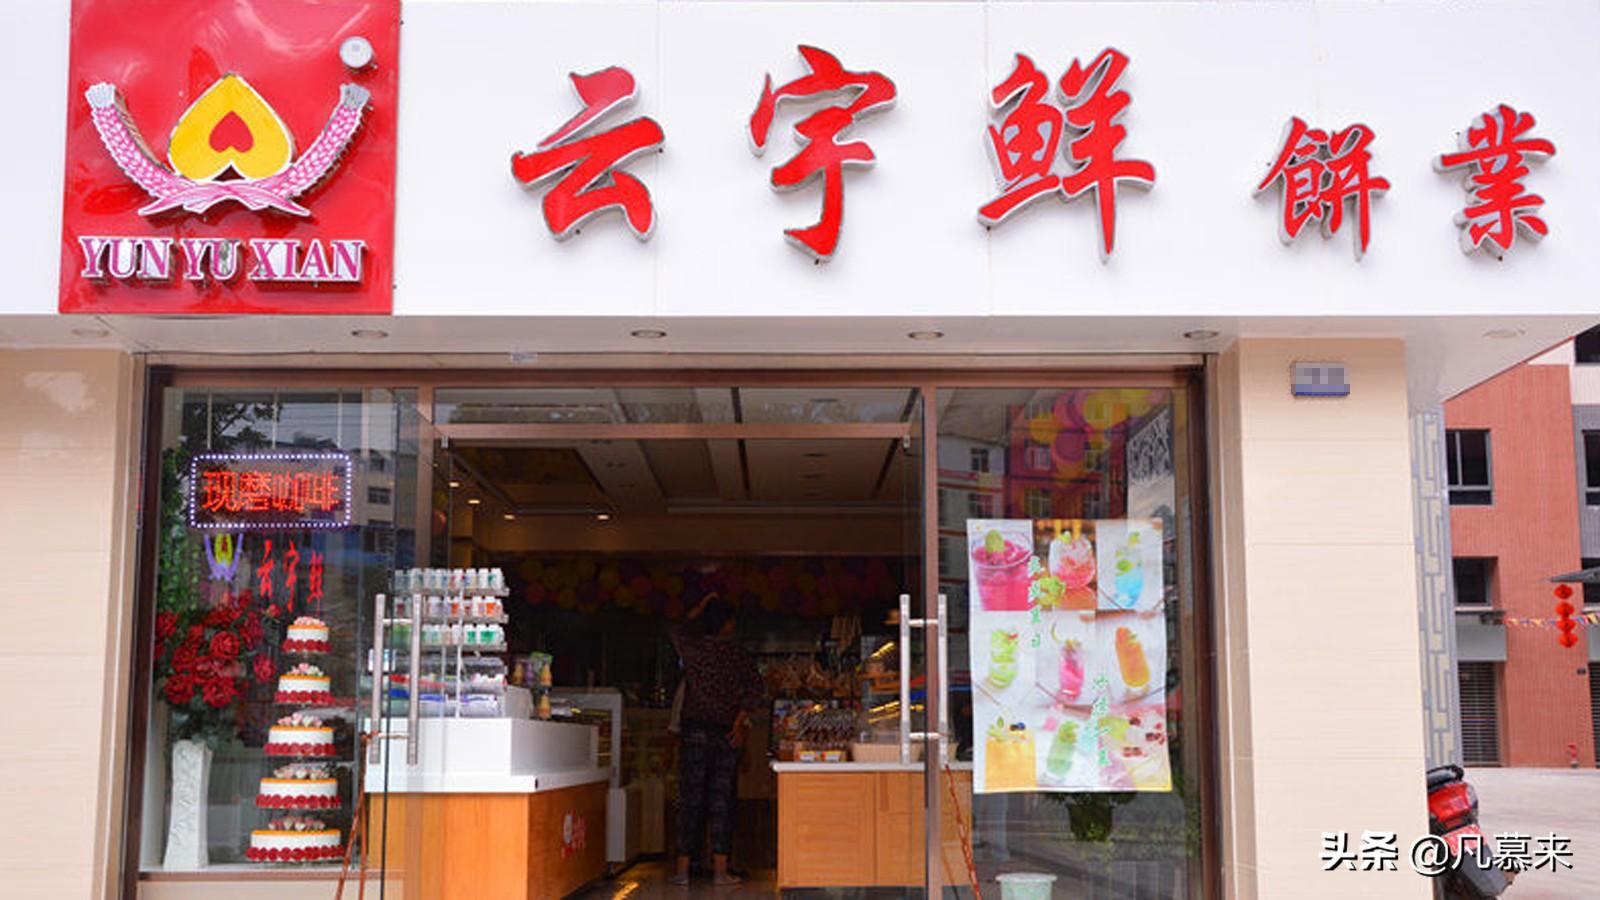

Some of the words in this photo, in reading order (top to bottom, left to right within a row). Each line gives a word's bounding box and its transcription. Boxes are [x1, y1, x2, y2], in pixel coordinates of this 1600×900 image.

[79, 236, 172, 279] YUN
[181, 238, 241, 279] YU
[248, 239, 365, 282] XIAN
[202, 469, 340, 512] 现磨咖啡
